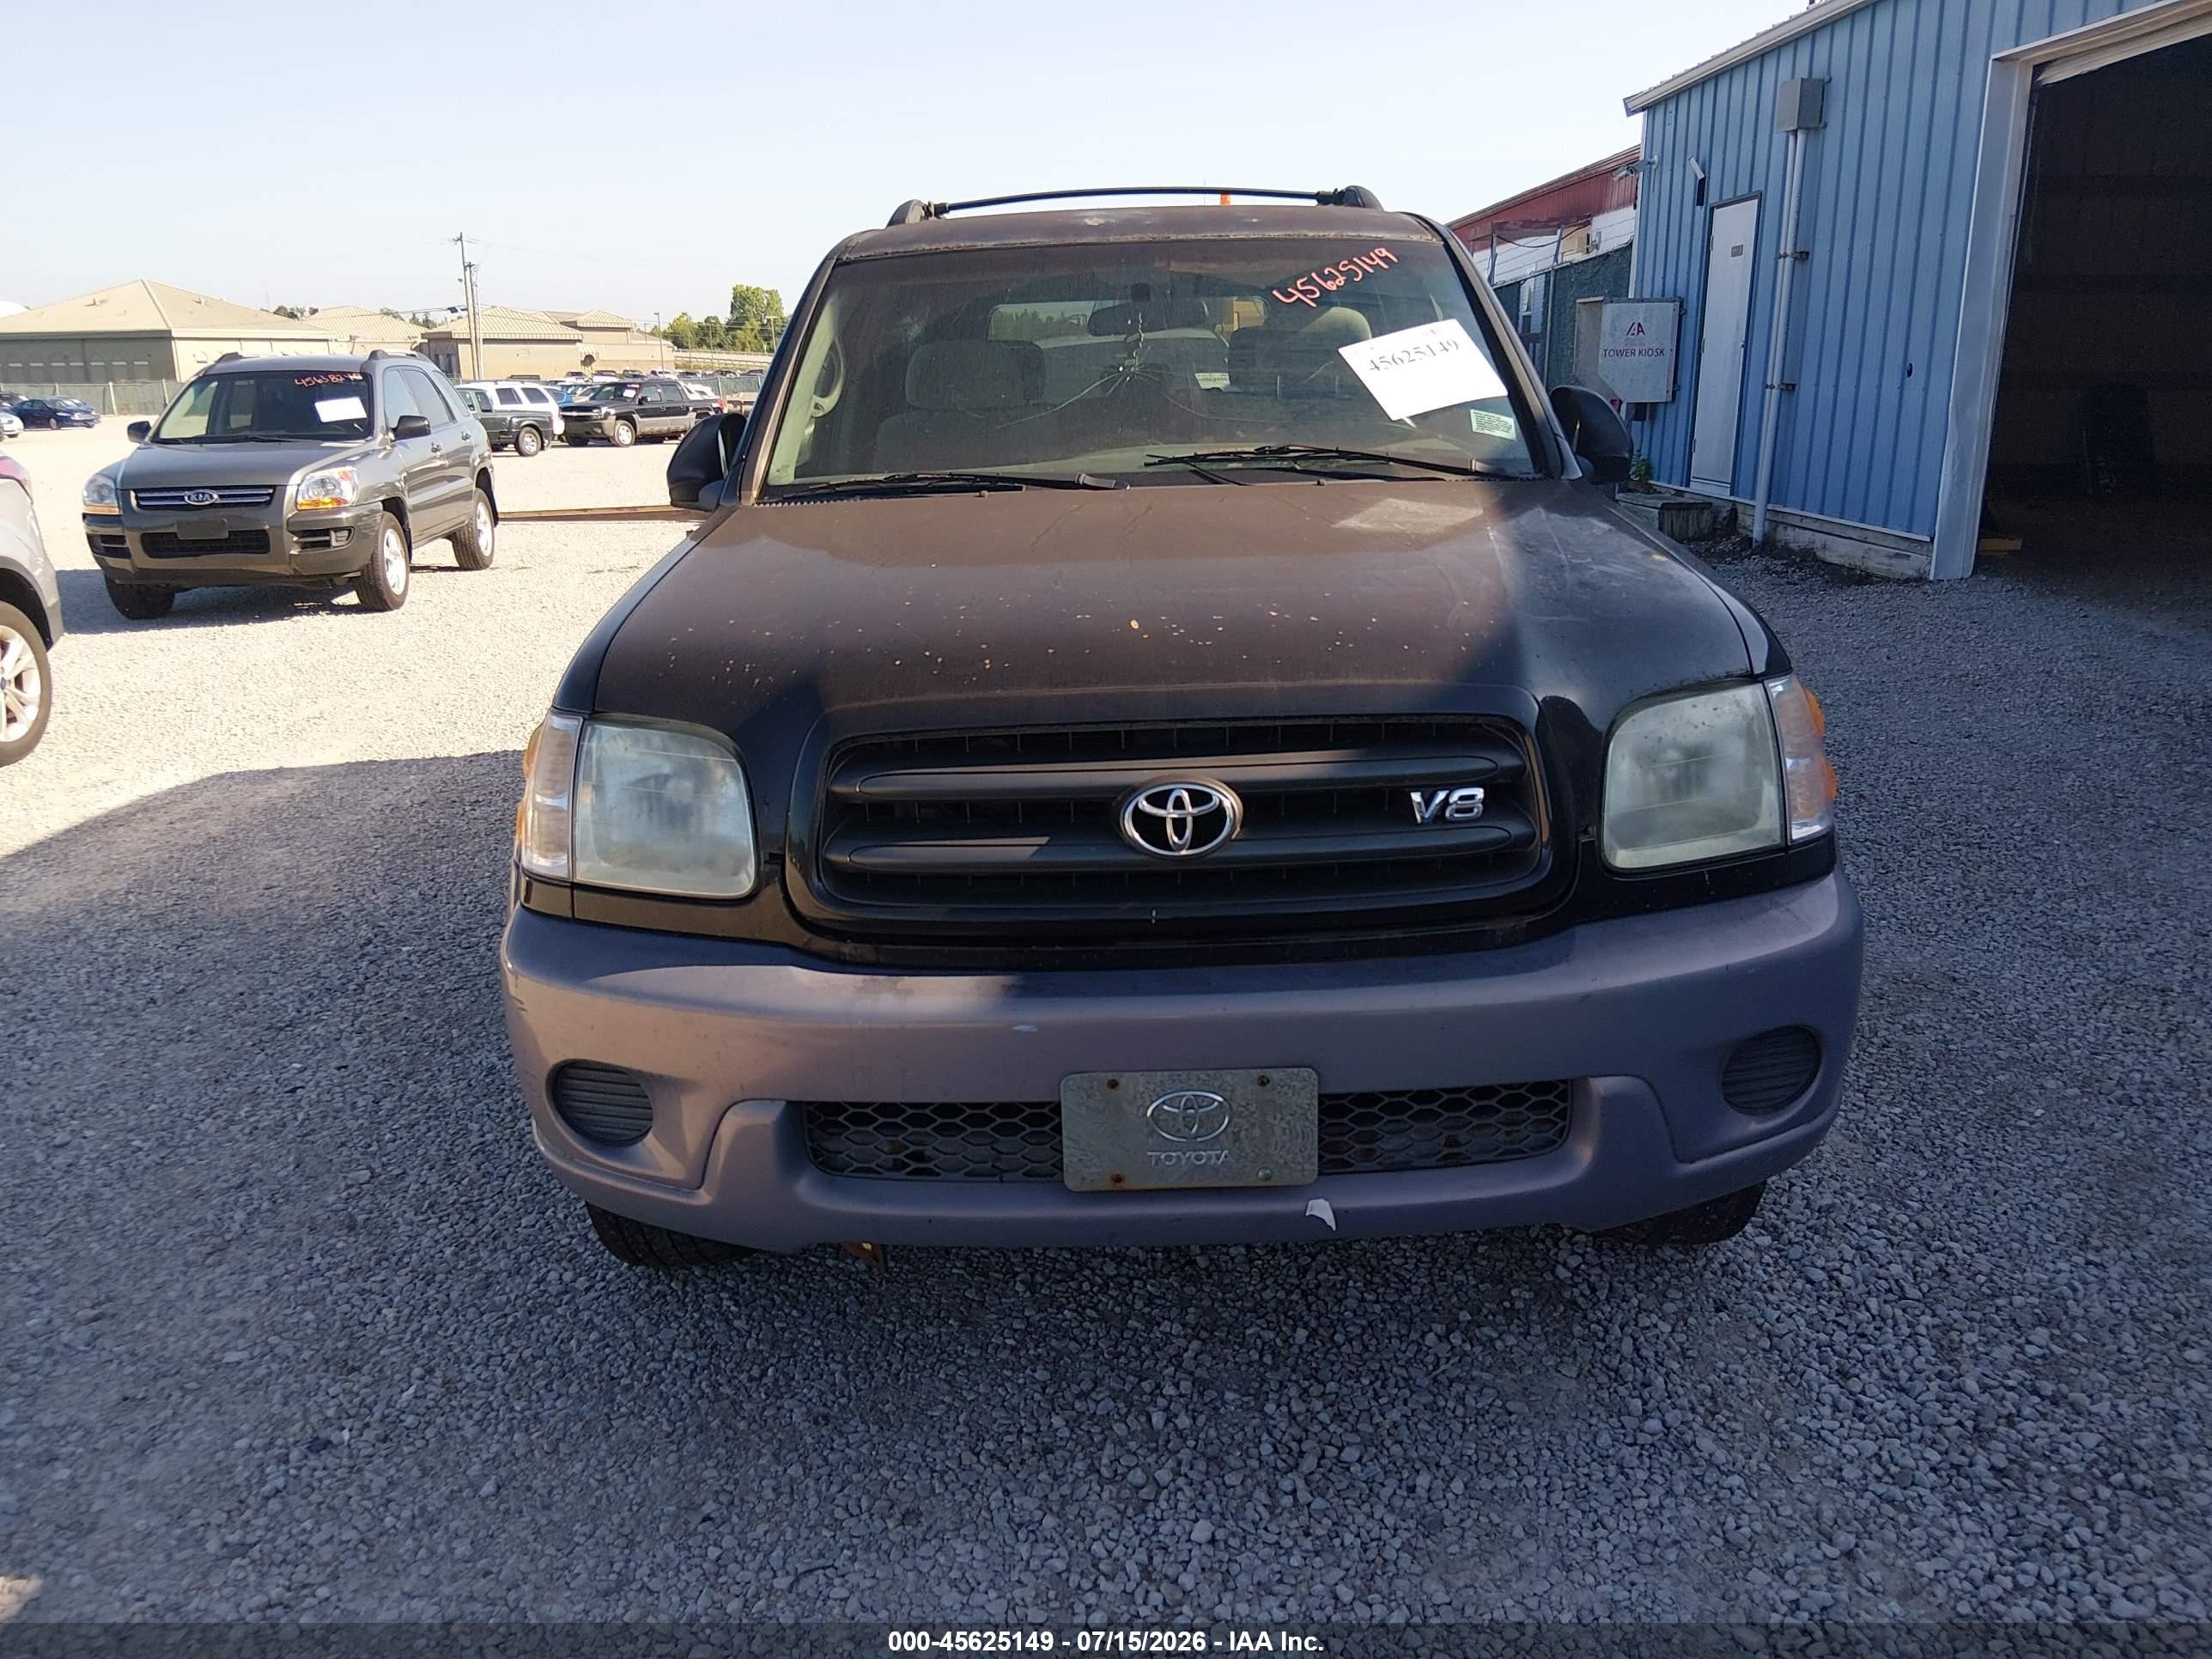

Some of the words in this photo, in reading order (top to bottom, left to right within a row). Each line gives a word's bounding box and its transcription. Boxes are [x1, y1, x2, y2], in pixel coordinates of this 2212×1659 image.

[1272, 246, 1399, 308] 45625149
[1370, 338, 1460, 372] 45625149
[1602, 348, 1636, 358] TOWER
[1638, 347, 1665, 357] KIOSK
[1410, 787, 1485, 824] V8
[1146, 1150, 1234, 1168] TOYOTA
